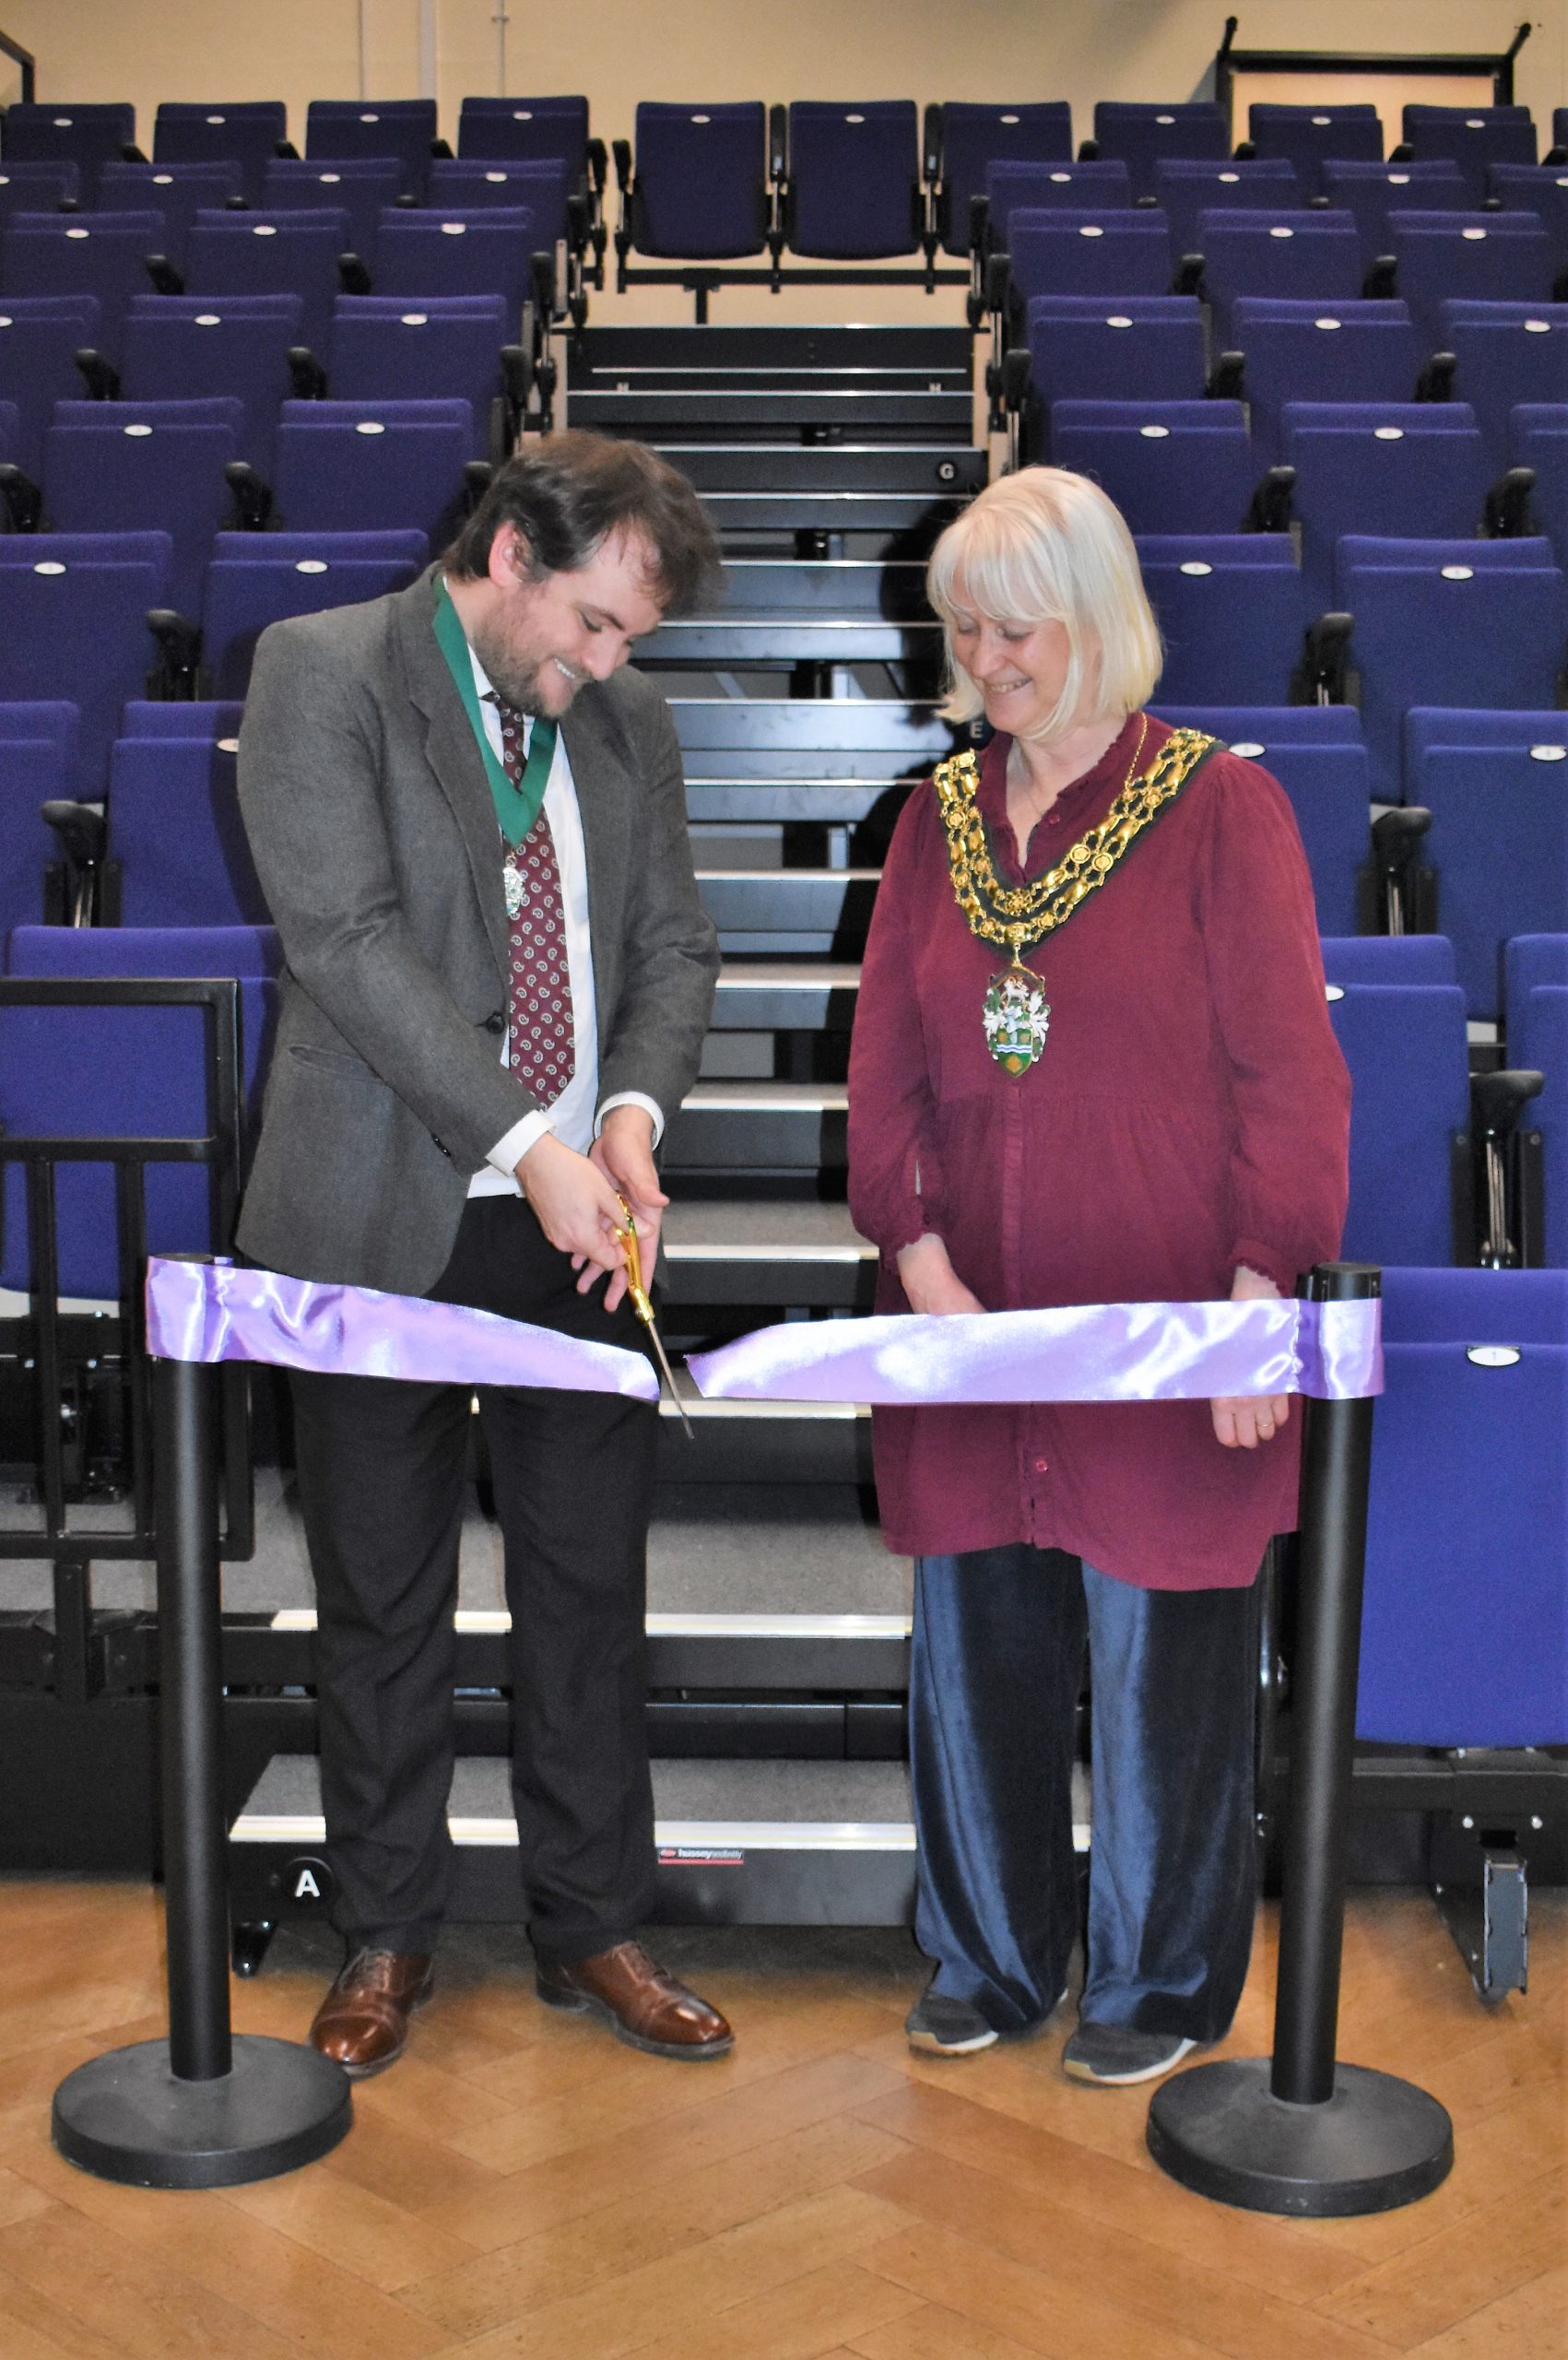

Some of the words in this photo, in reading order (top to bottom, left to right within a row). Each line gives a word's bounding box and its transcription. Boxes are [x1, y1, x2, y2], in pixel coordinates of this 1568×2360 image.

[938, 463, 955, 480] G
[970, 721, 984, 738] E
[295, 1869, 321, 1898] A
